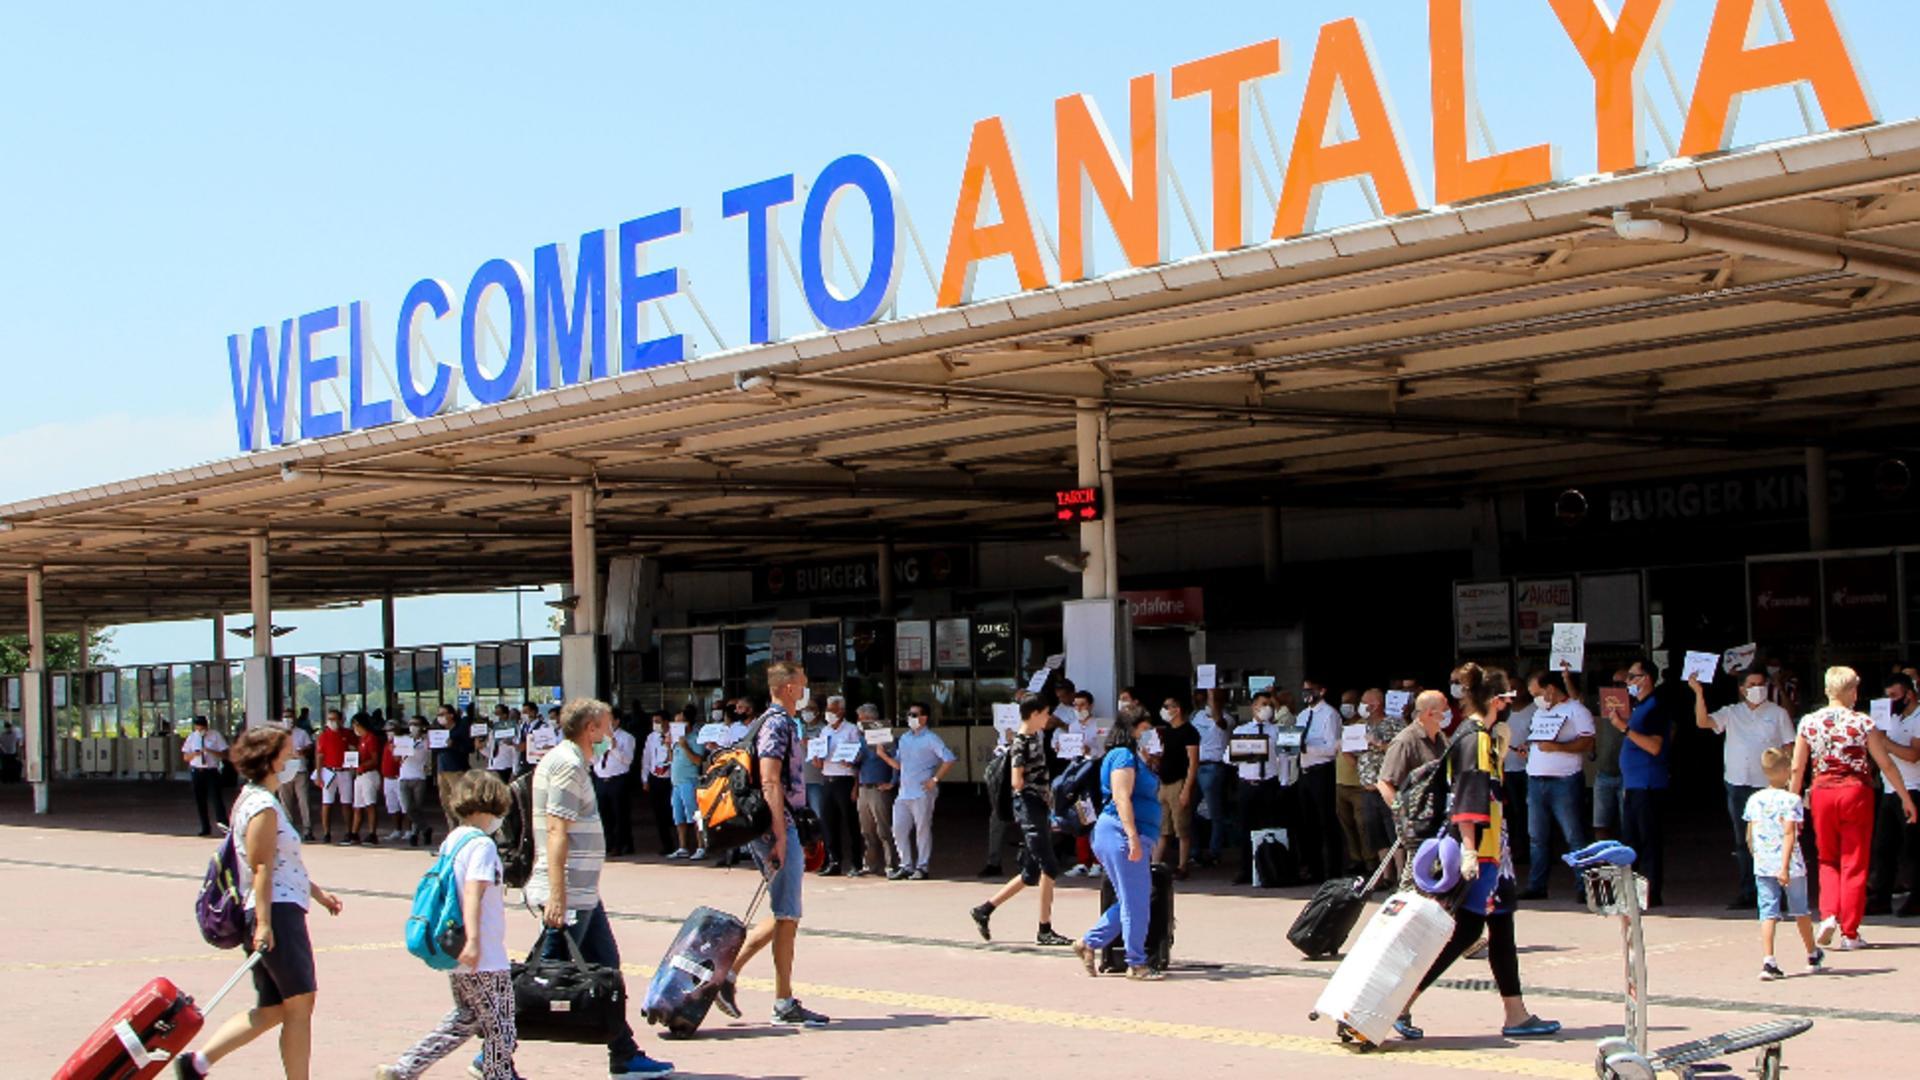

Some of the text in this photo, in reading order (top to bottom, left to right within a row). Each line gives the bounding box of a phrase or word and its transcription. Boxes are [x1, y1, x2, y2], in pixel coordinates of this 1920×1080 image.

[228, 0, 1873, 451] WELCOME TO ANTALYA
[1608, 480, 1745, 523] BURGER
[796, 557, 920, 592] BURGER KNG
[1130, 597, 1184, 616] odafone
